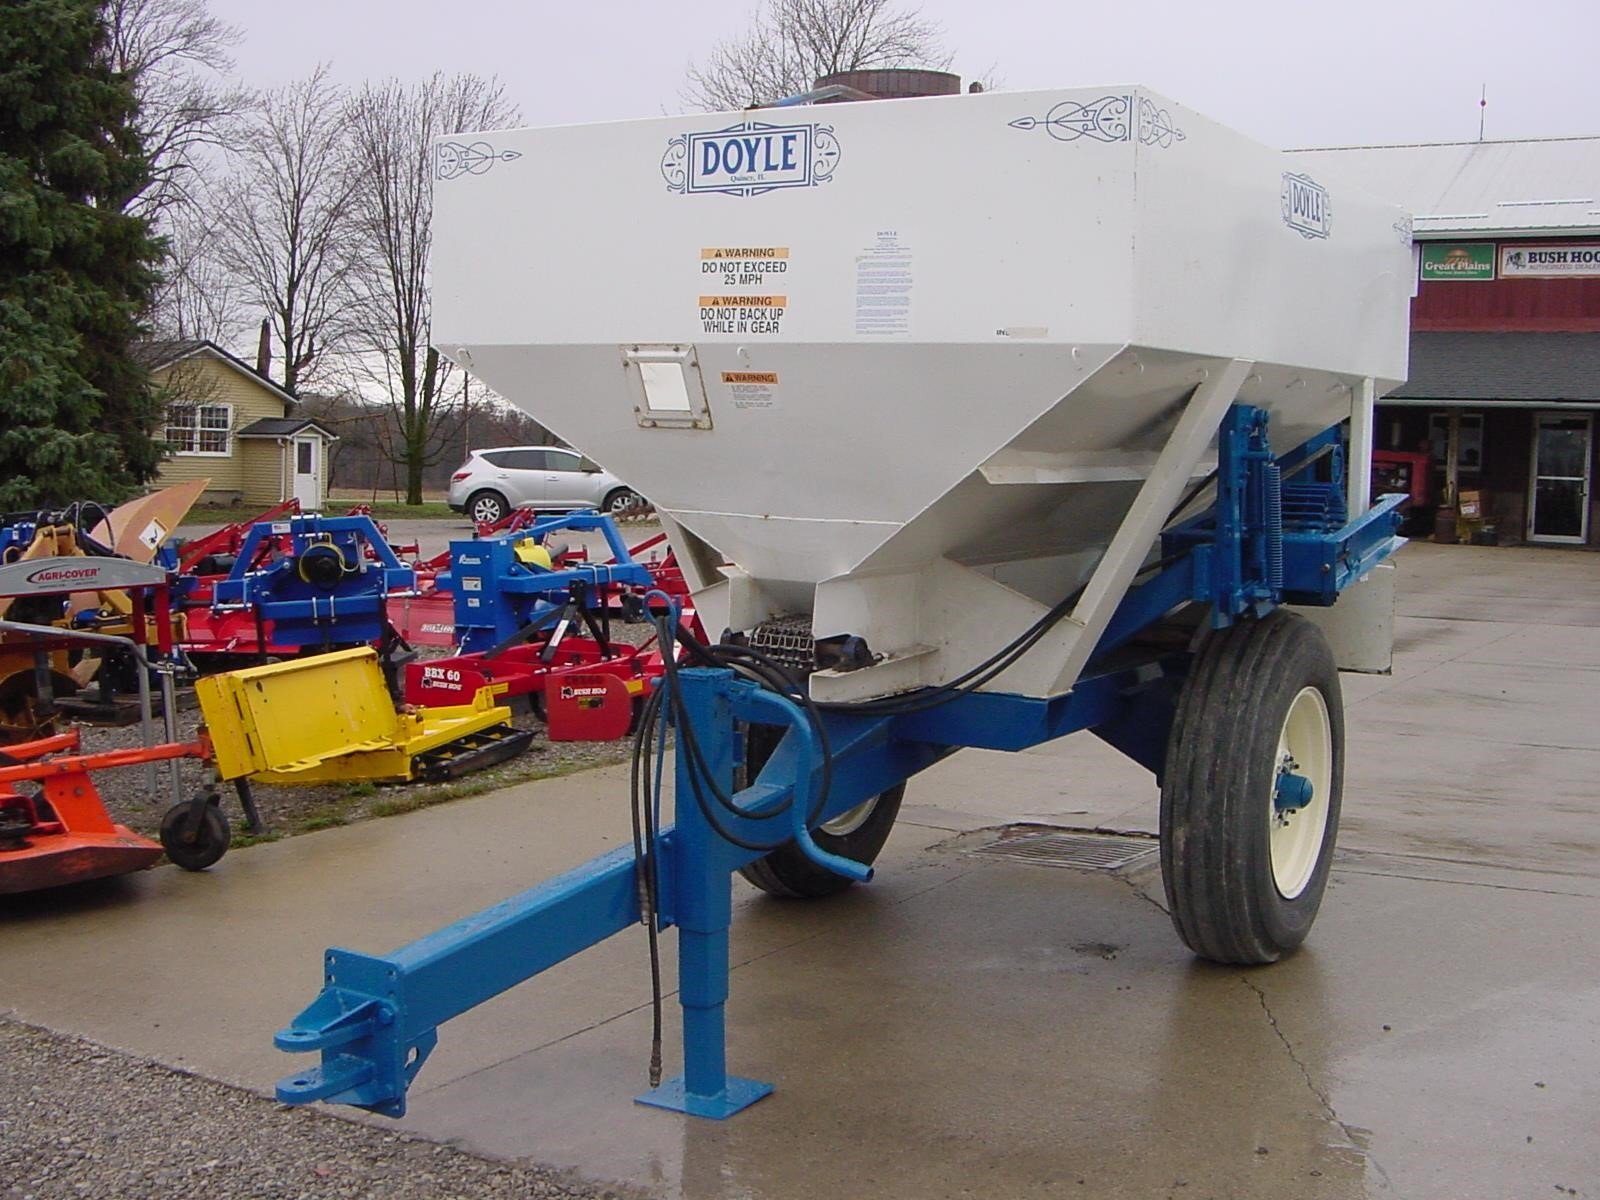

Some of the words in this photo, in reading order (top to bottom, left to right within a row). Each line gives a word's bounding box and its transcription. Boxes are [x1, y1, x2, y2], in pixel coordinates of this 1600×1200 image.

[701, 135, 797, 176] DOYLE
[1293, 182, 1321, 222] DOYLE
[725, 248, 775, 258] WARNING
[1528, 251, 1568, 263] BUSH
[702, 262, 718, 273] DO
[720, 262, 741, 273] NOT
[744, 261, 787, 273] EXCEED
[1425, 261, 1456, 270] Great
[1457, 260, 1490, 270] Plains
[724, 274, 736, 285] 25
[739, 273, 763, 285] MPH
[722, 296, 772, 306] WARNING
[701, 308, 715, 320] DO
[717, 308, 737, 320] NOT
[740, 308, 767, 320] BACK
[770, 308, 784, 320] UP
[703, 321, 734, 333] WHILE
[737, 321, 747, 333] IN
[751, 321, 779, 333] GEAR
[38, 568, 97, 581] AGRI-COVER
[424, 667, 445, 679] BBX
[447, 670, 461, 681] 60
